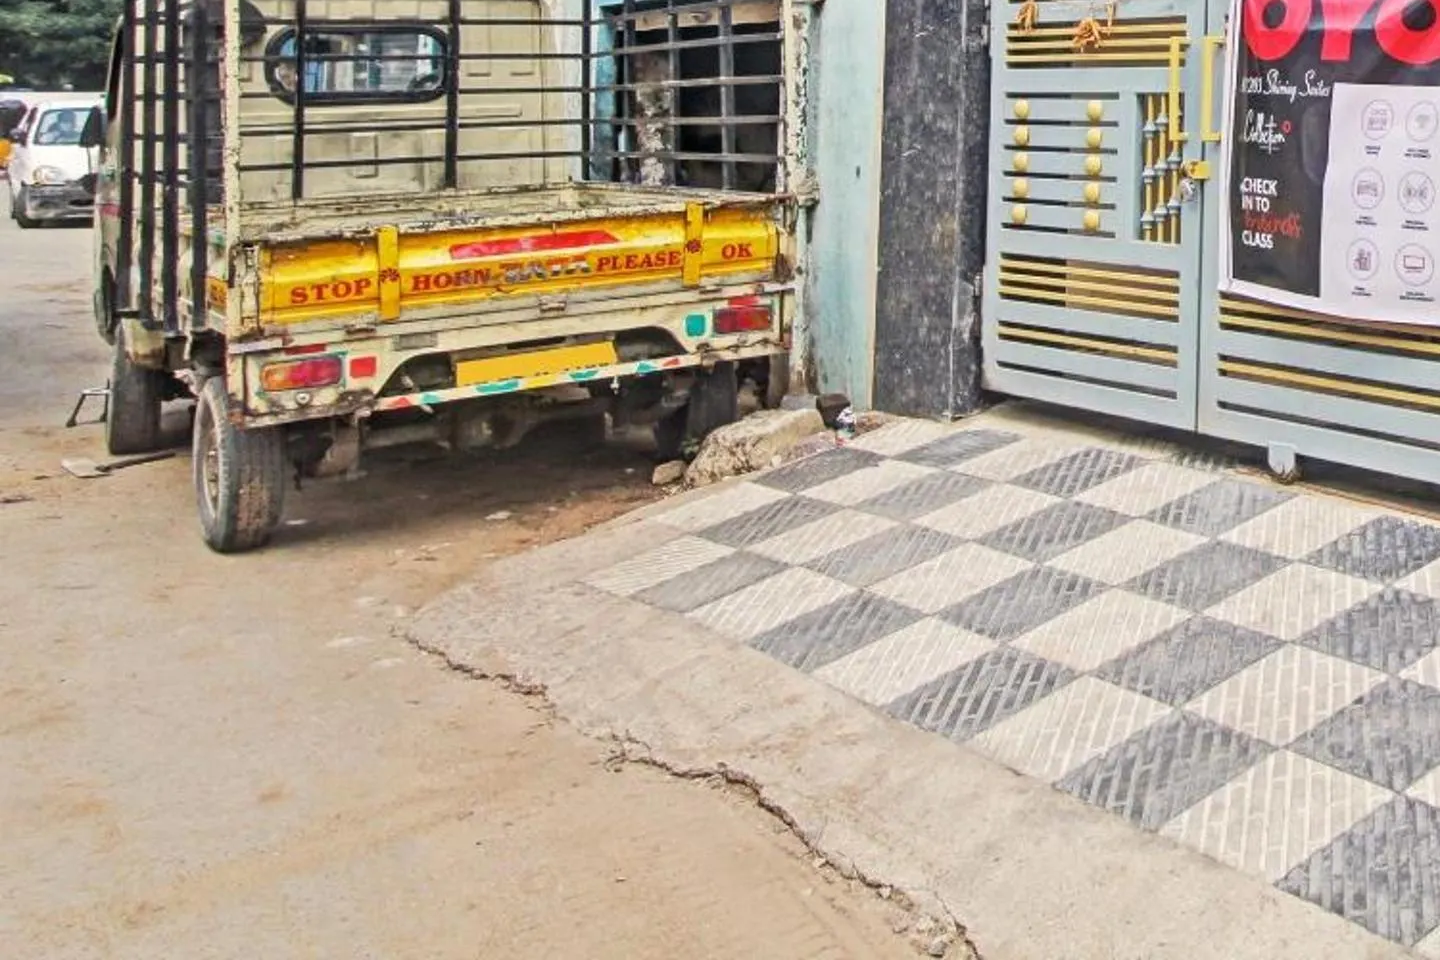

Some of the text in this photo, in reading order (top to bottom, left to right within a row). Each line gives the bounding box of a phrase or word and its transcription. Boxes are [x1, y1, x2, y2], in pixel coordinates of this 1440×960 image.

[1241, 177, 1278, 196] CHECK
[1242, 195, 1270, 212] IN TO
[1242, 230, 1274, 249] CLASS
[291, 278, 371, 304] STOP
[412, 268, 491, 291] HORN
[596, 250, 682, 272] PLEASE
[721, 243, 753, 260] OK
